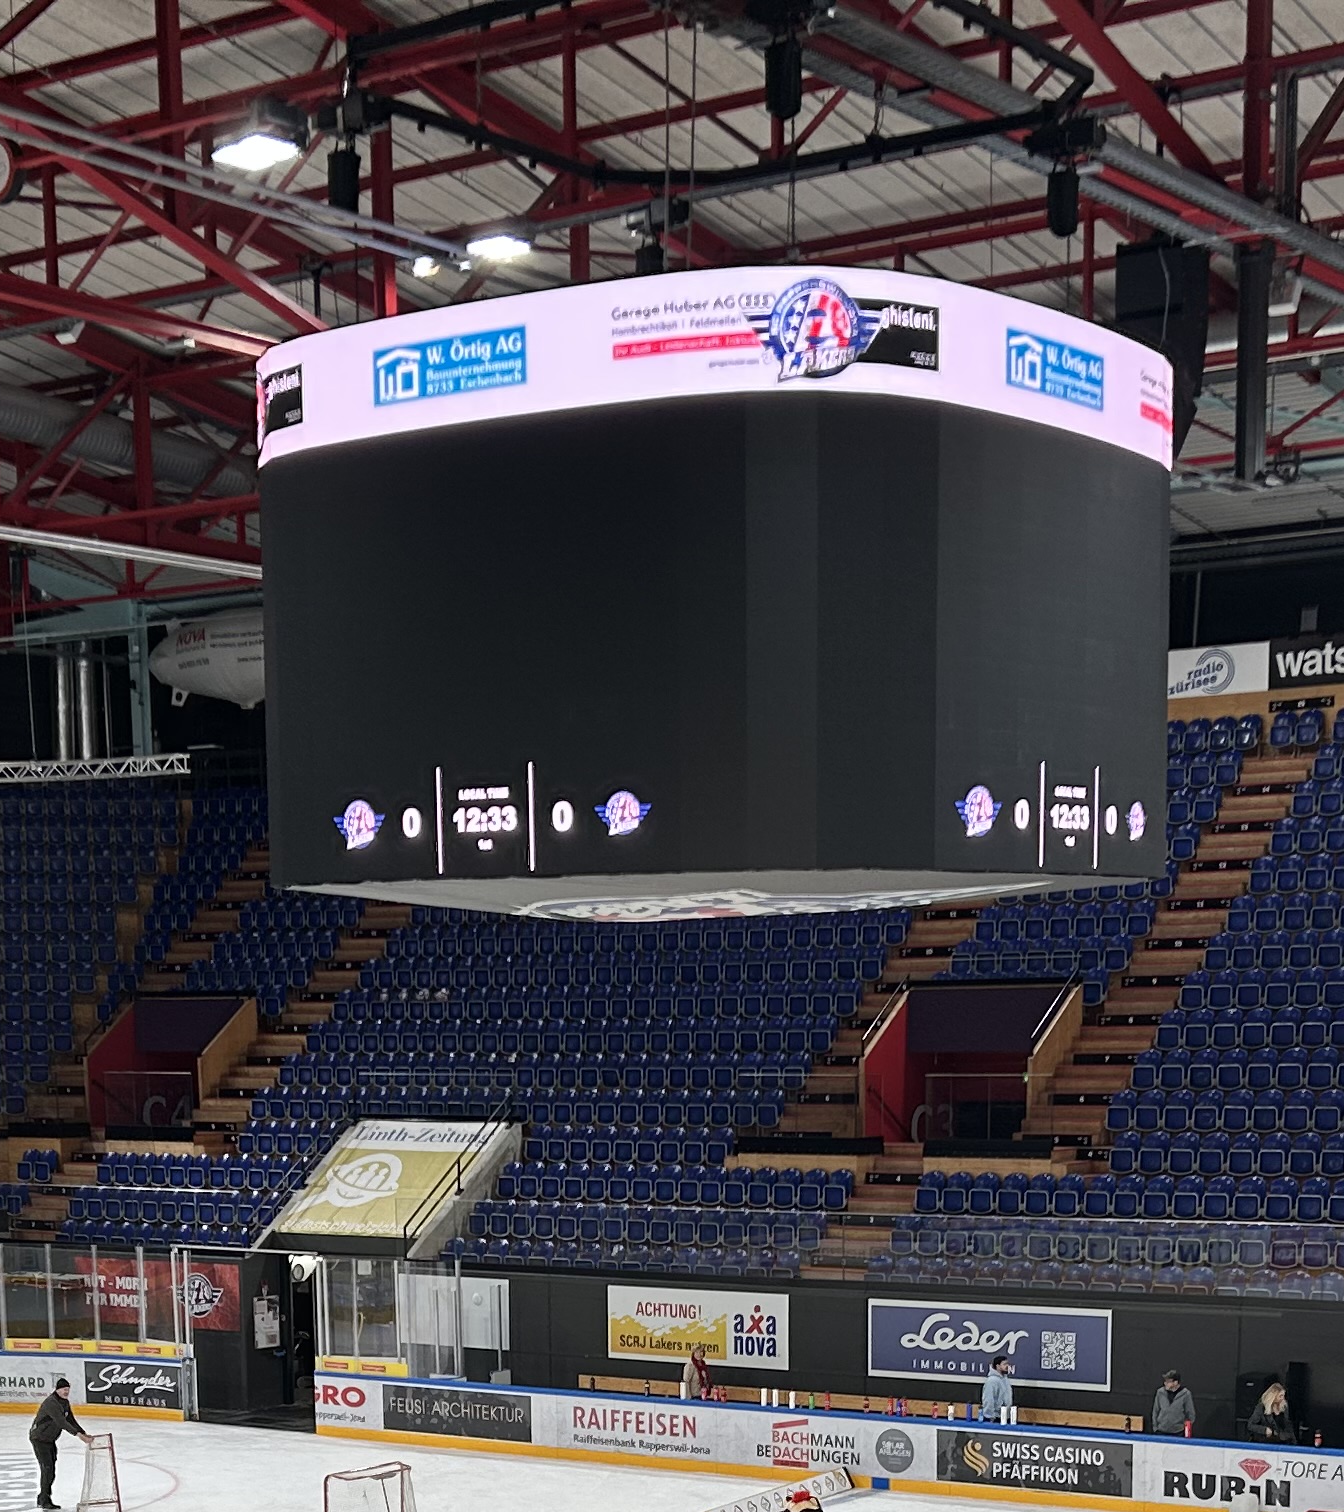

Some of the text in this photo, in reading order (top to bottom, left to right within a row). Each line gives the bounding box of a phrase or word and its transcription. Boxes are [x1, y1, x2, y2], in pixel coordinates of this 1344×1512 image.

[611, 294, 735, 322] Garage Huber AG
[426, 332, 522, 366] W. Örtig AG
[1187, 660, 1224, 681] radio
[402, 807, 422, 838] 0
[453, 805, 518, 833] 12:33
[551, 800, 574, 832] 0
[1014, 798, 1030, 830] 0
[1050, 803, 1090, 831] 12:33
[1105, 805, 1118, 836] 0
[354, 1124, 495, 1148] Linth-Zeitung
[635, 1301, 703, 1320] ACHTUNG!
[733, 1305, 777, 1336] axa
[619, 1334, 683, 1352] SCRJ Lakers
[733, 1335, 778, 1359] nova
[901, 1312, 1030, 1355] Leder
[104, 1394, 168, 1408] MODEHAUS
[432, 1400, 525, 1424] ARCHITEKTUR
[572, 1406, 697, 1440] RAIFFEISEN
[771, 1430, 855, 1450] BACHMANN
[756, 1444, 861, 1466] BEDACHUNGEN
[992, 1441, 1104, 1467] SWISS CASINO
[992, 1460, 1079, 1486] PFÄFFIKON
